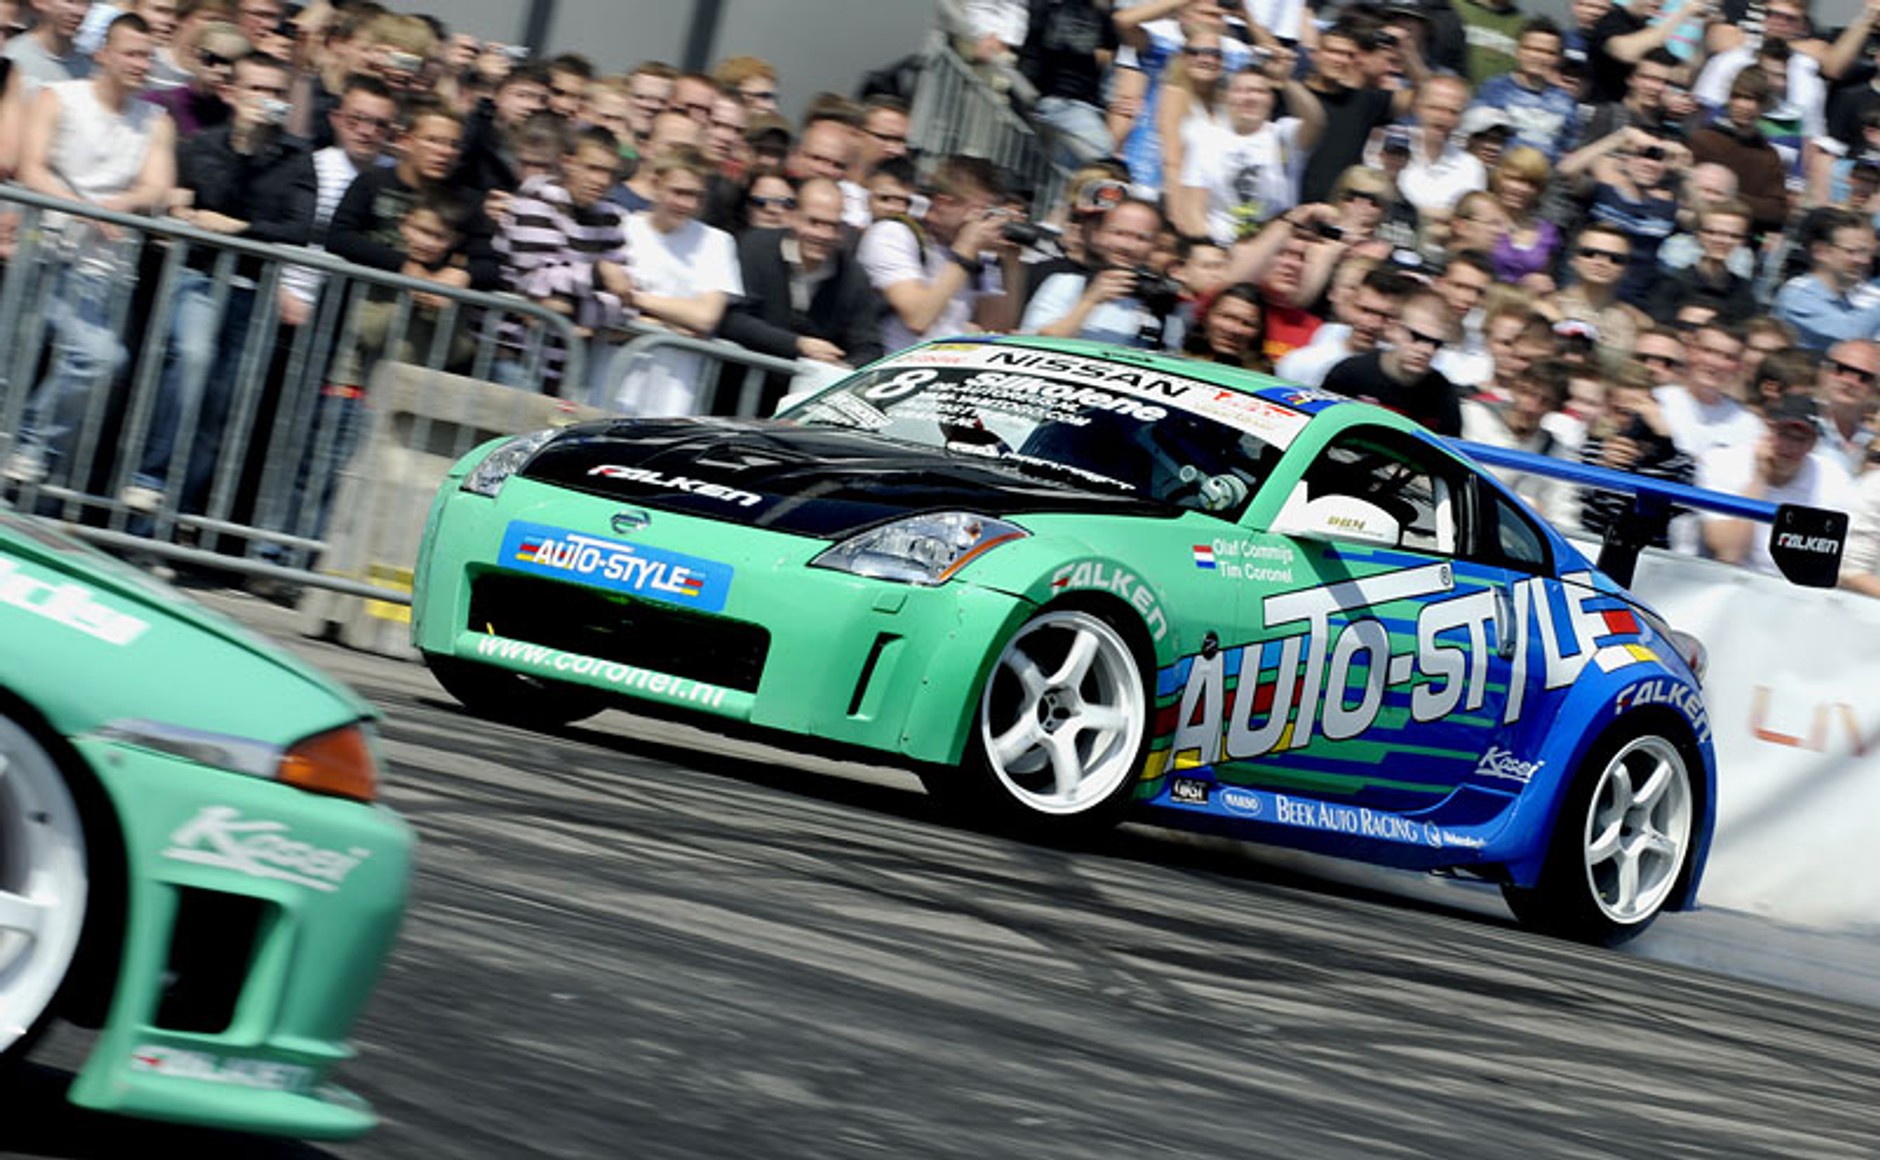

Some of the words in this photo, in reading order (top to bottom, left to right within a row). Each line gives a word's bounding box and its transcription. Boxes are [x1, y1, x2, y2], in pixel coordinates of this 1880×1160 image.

[864, 368, 939, 399] 8
[986, 352, 1190, 397] NISSAN
[587, 464, 763, 507] FALKEN
[533, 533, 690, 594] AUTO-STYLE
[1212, 538, 1239, 556] Olaf
[1776, 532, 1839, 555] FALKEN
[1218, 560, 1243, 578] Tim
[1245, 562, 1294, 584] Coronel
[1051, 560, 1168, 641] FALKEN
[477, 636, 728, 708] www.coronel.nl
[1165, 561, 1630, 772] AUTO-STYLE
[1615, 680, 1713, 744] FALKEN
[1474, 746, 1546, 784] Kosei
[1318, 801, 1358, 833] AUTO
[1360, 808, 1419, 842] RACING
[160, 805, 373, 892] Kosei
